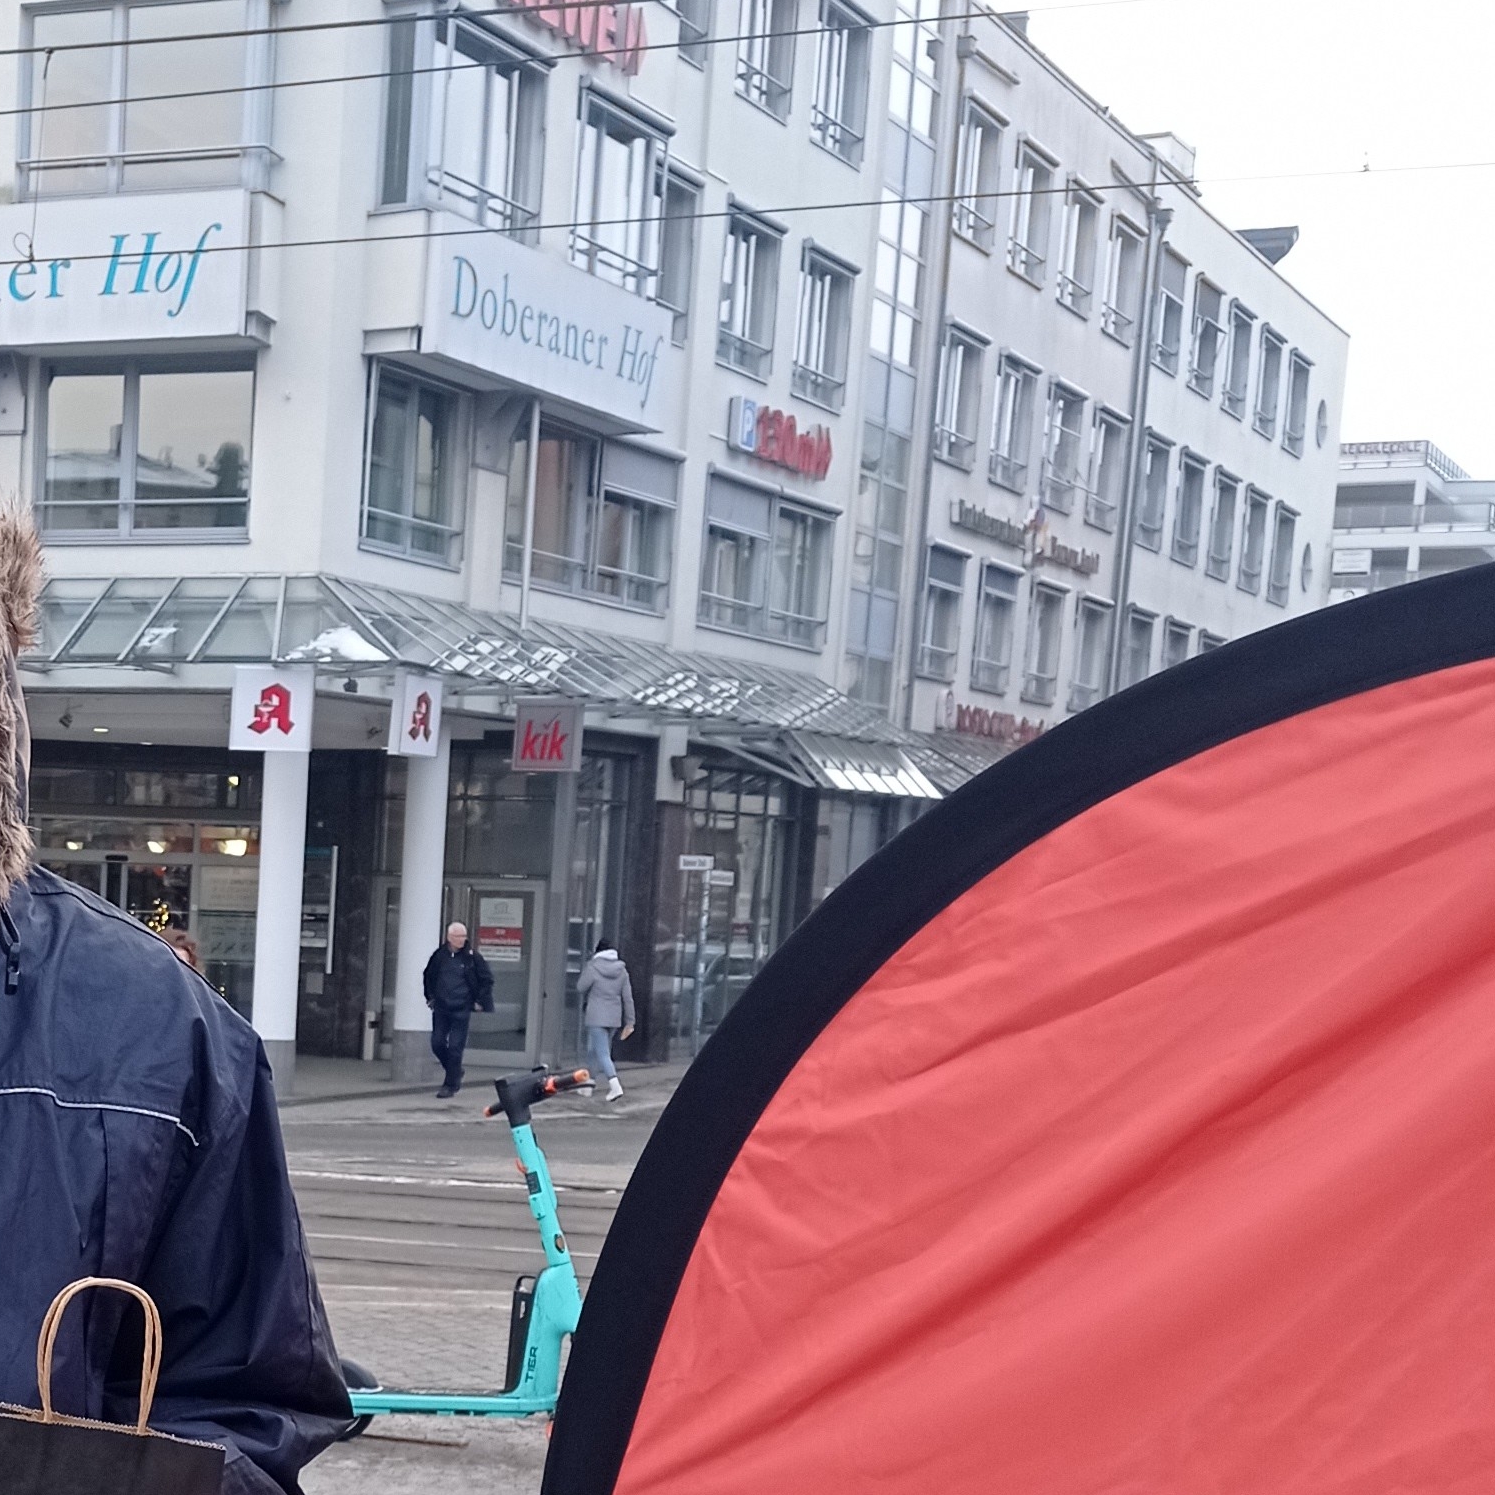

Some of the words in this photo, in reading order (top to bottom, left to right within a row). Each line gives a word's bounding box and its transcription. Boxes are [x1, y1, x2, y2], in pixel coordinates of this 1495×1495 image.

[98, 222, 223, 318] Hof
[450, 255, 609, 370] Doberaner
[615, 323, 664, 409] Hof
[524, 1346, 539, 1384] TIER
